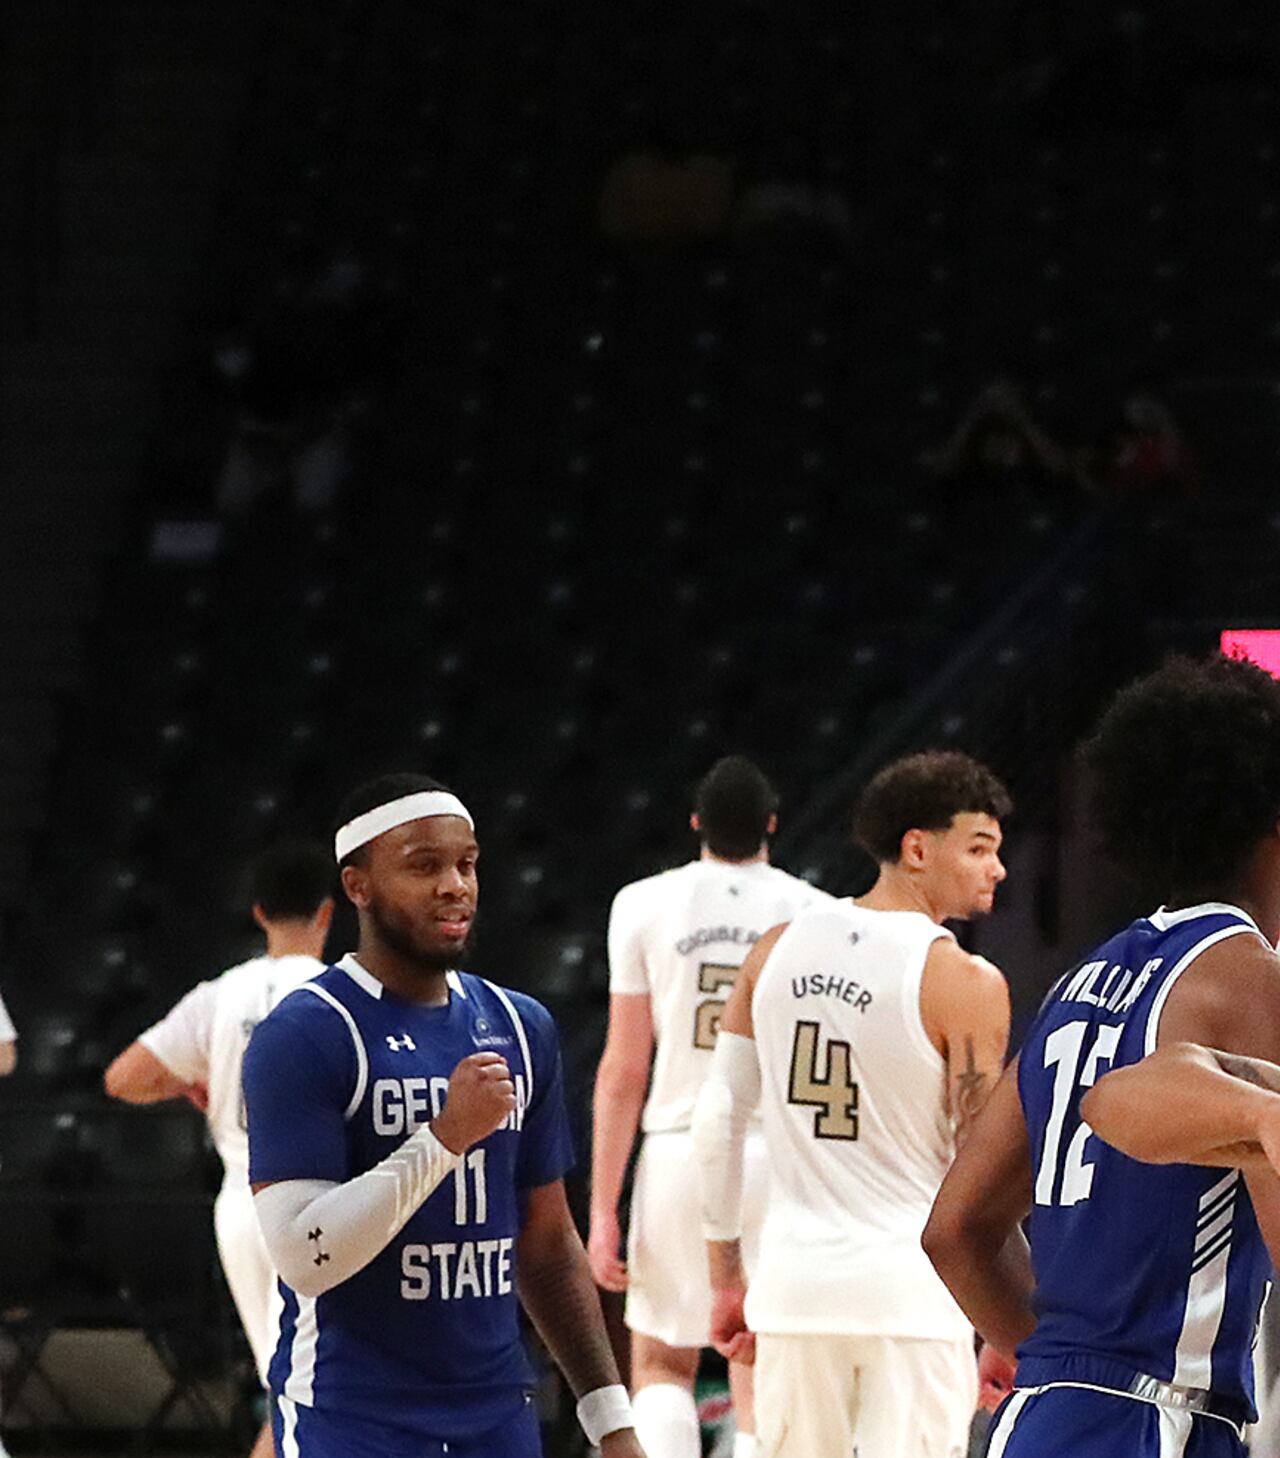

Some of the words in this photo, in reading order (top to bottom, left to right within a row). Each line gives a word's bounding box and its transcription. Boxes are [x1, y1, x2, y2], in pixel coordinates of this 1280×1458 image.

[792, 974, 873, 1014] USHER
[787, 1020, 859, 1141] 4
[452, 1148, 488, 1226] 11
[400, 1237, 514, 1301] STATE
